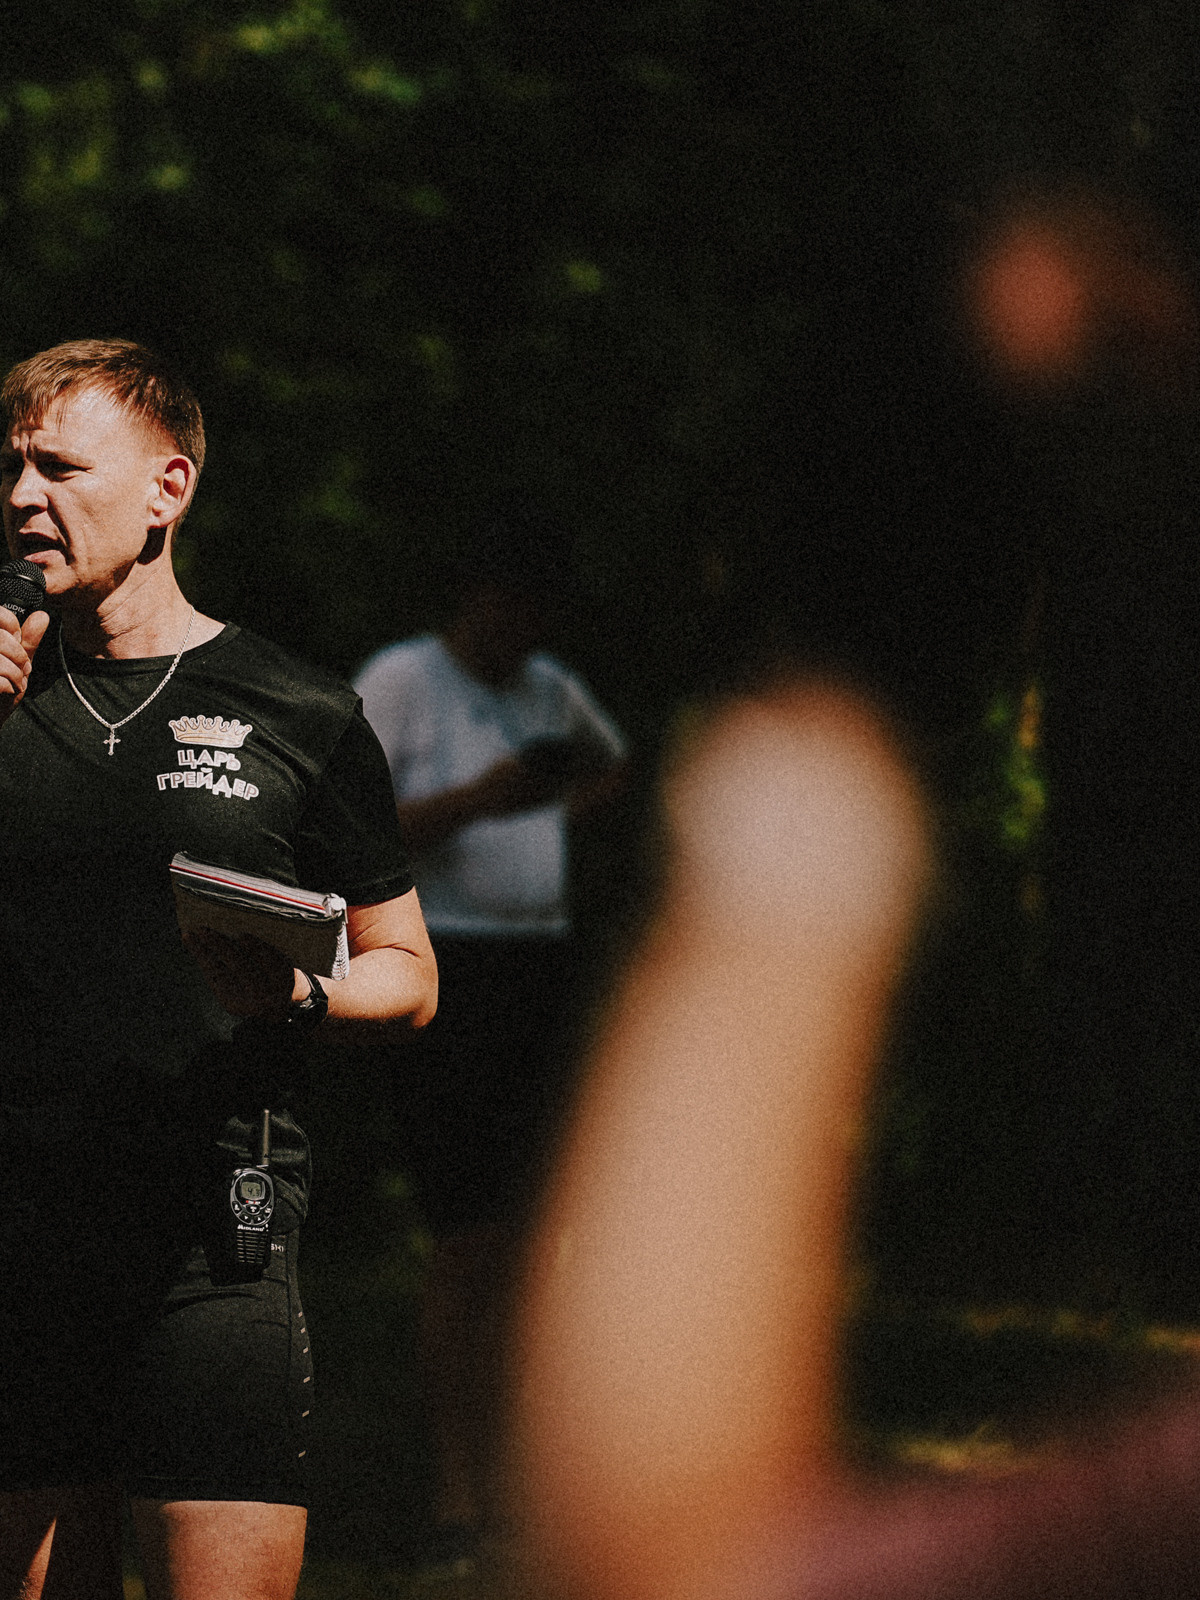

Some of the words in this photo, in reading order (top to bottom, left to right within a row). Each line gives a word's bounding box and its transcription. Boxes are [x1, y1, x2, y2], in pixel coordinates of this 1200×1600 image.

[3, 603, 25, 614] AUDIX
[177, 749, 241, 771] ЦАРЬ
[157, 767, 259, 800] ГРЕЙДЕР
